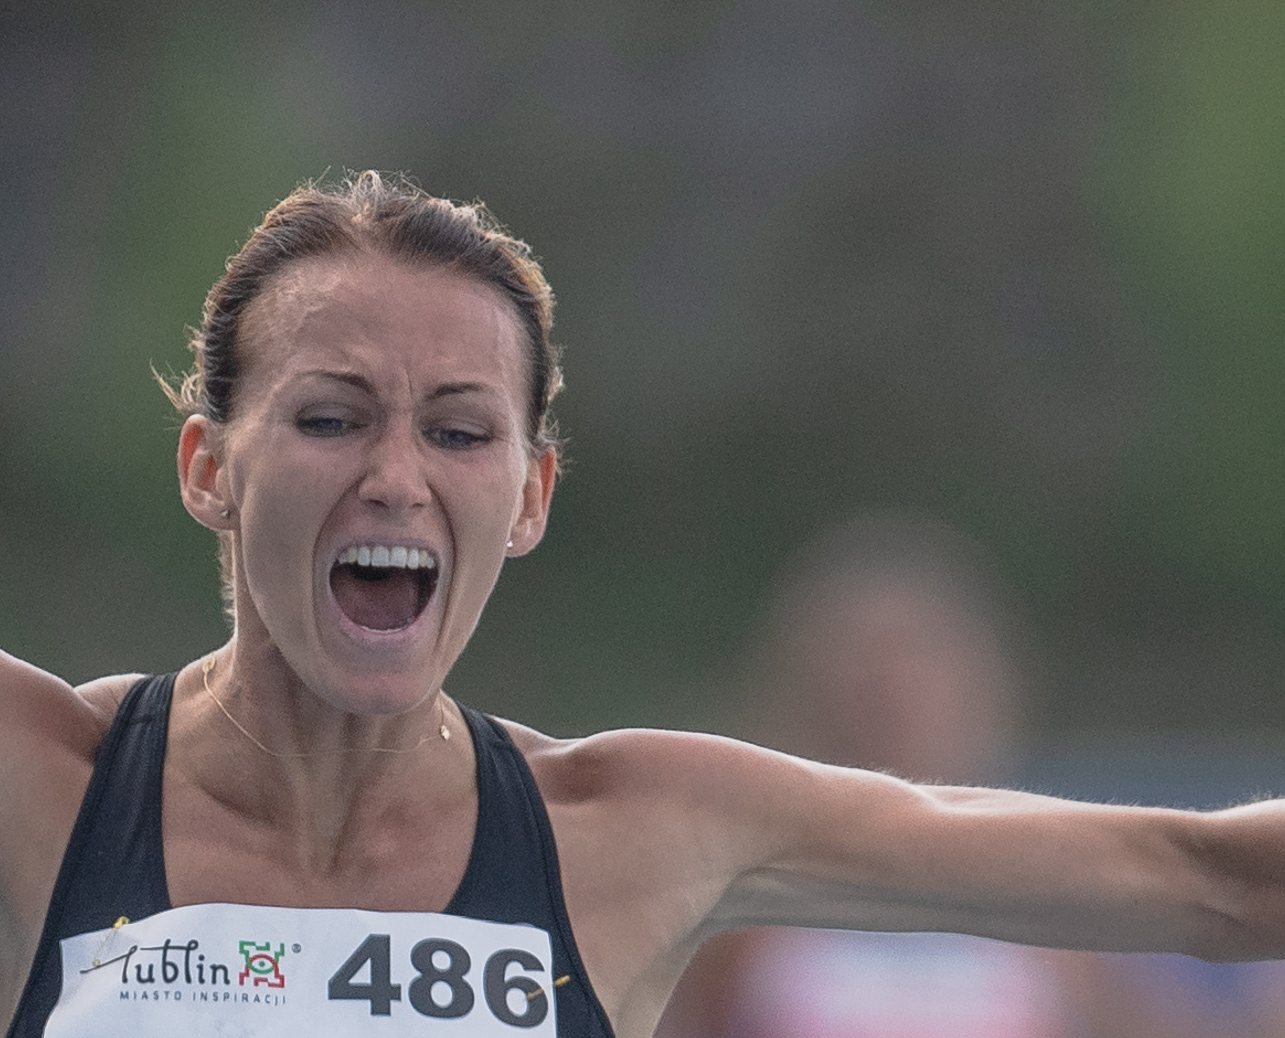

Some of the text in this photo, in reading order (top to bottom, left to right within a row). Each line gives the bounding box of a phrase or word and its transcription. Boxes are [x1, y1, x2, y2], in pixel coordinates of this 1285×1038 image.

[80, 939, 230, 985] lublin
[326, 932, 549, 1029] 486
[120, 990, 287, 1005] MIASTO INSPIRACJI
